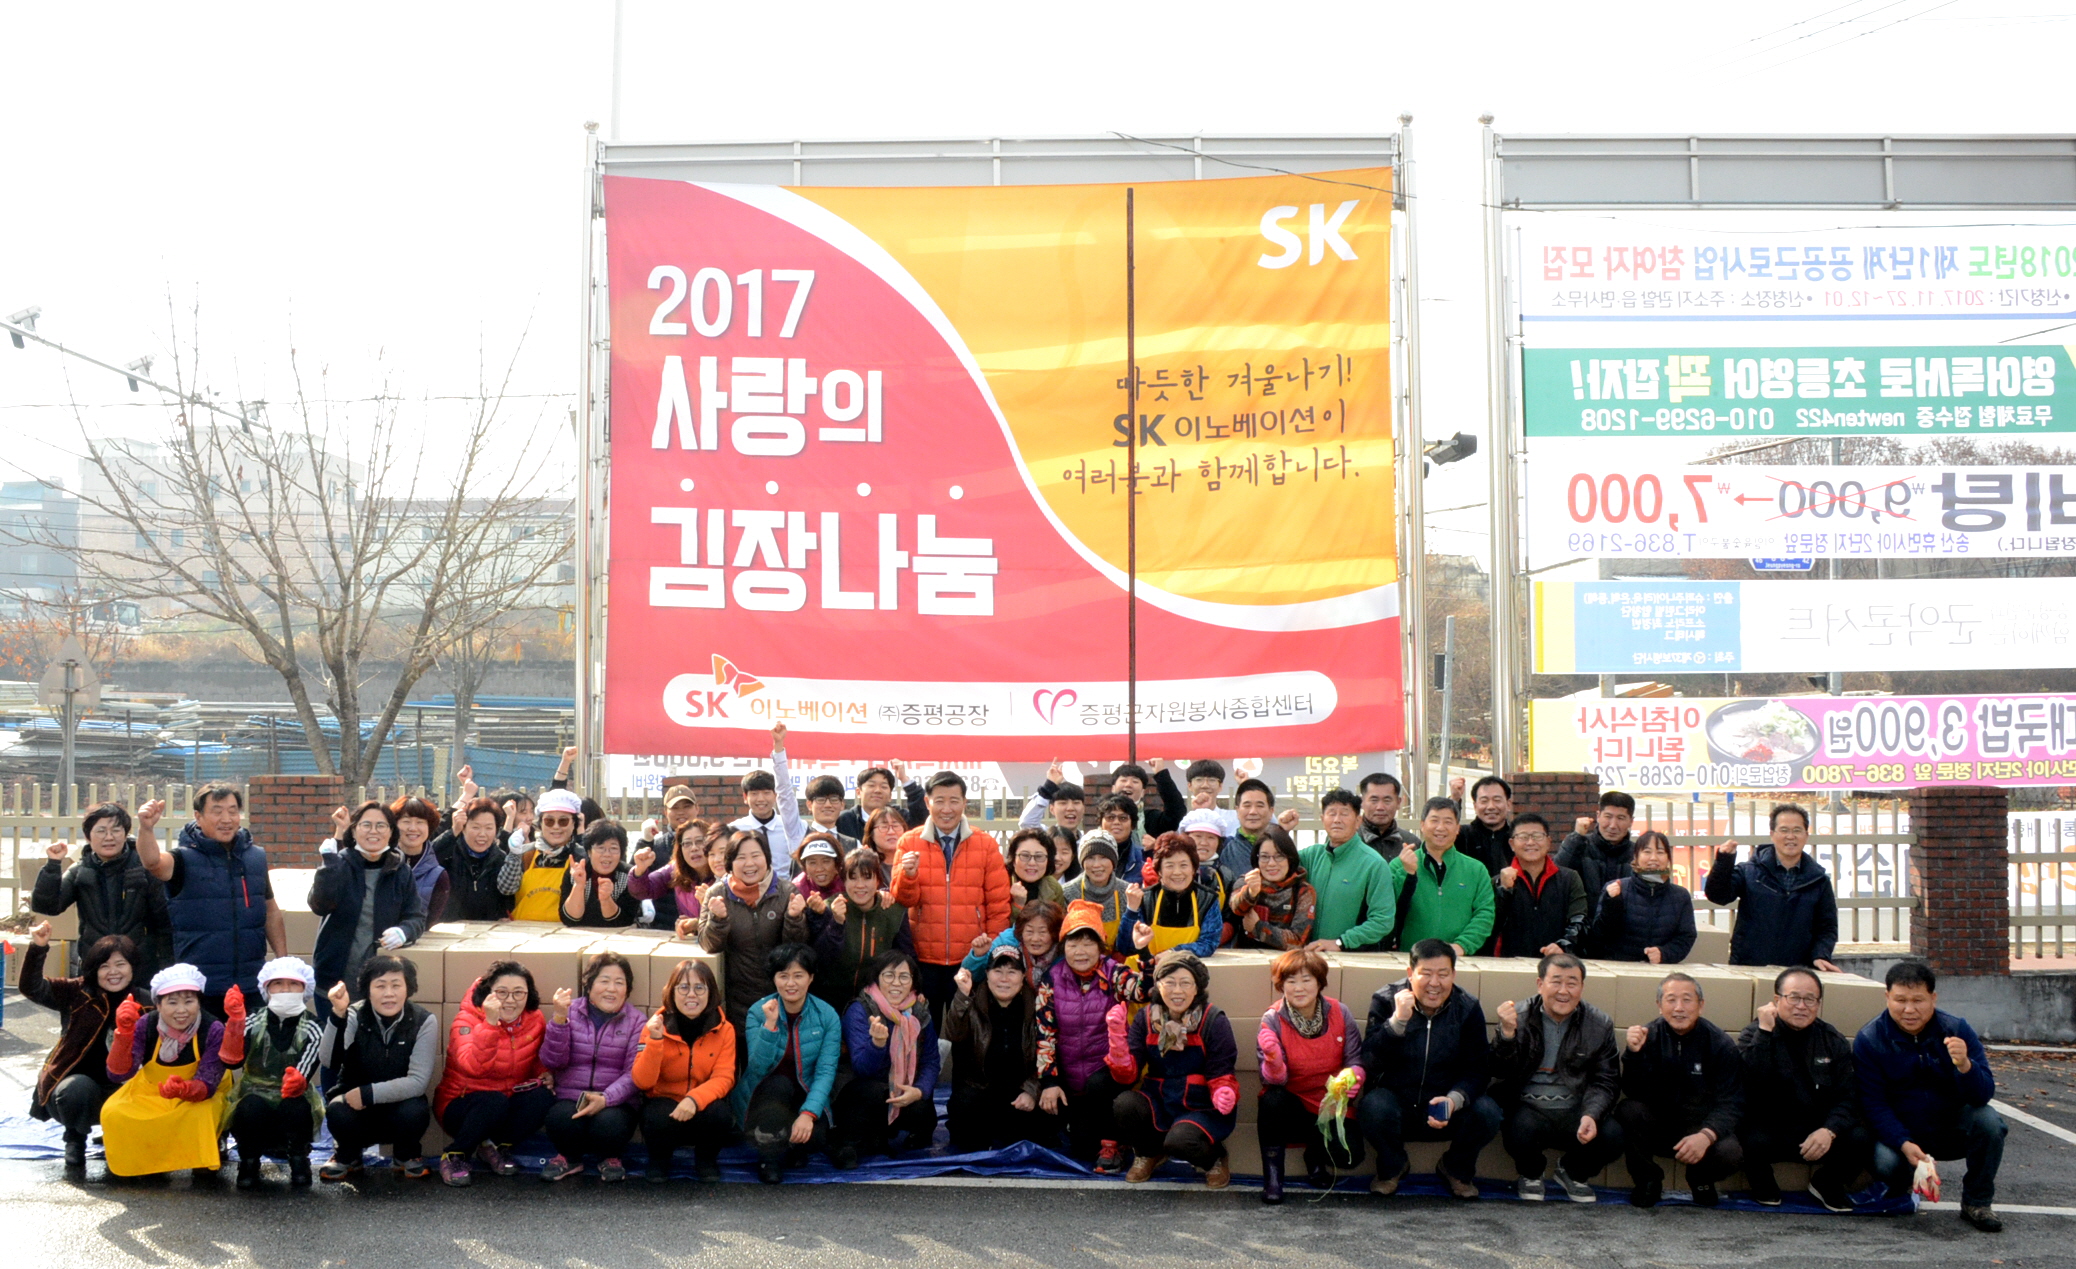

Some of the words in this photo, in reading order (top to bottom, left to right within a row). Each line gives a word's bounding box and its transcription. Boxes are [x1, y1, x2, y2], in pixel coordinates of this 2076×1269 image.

[1257, 198, 1360, 271] SK
[645, 262, 817, 340] 2017
[1225, 352, 1354, 398] 겨울나기!
[650, 352, 886, 460] 사랑의
[1111, 412, 1169, 448] SK
[1062, 456, 1183, 496] 여러분과
[1197, 443, 1361, 493] 함께합니다.
[647, 505, 1000, 618] 김장나눔
[684, 688, 731, 720] SK
[749, 696, 869, 726] 이노베이션
[1078, 691, 1314, 727] 증평군자원봉사종합센터
